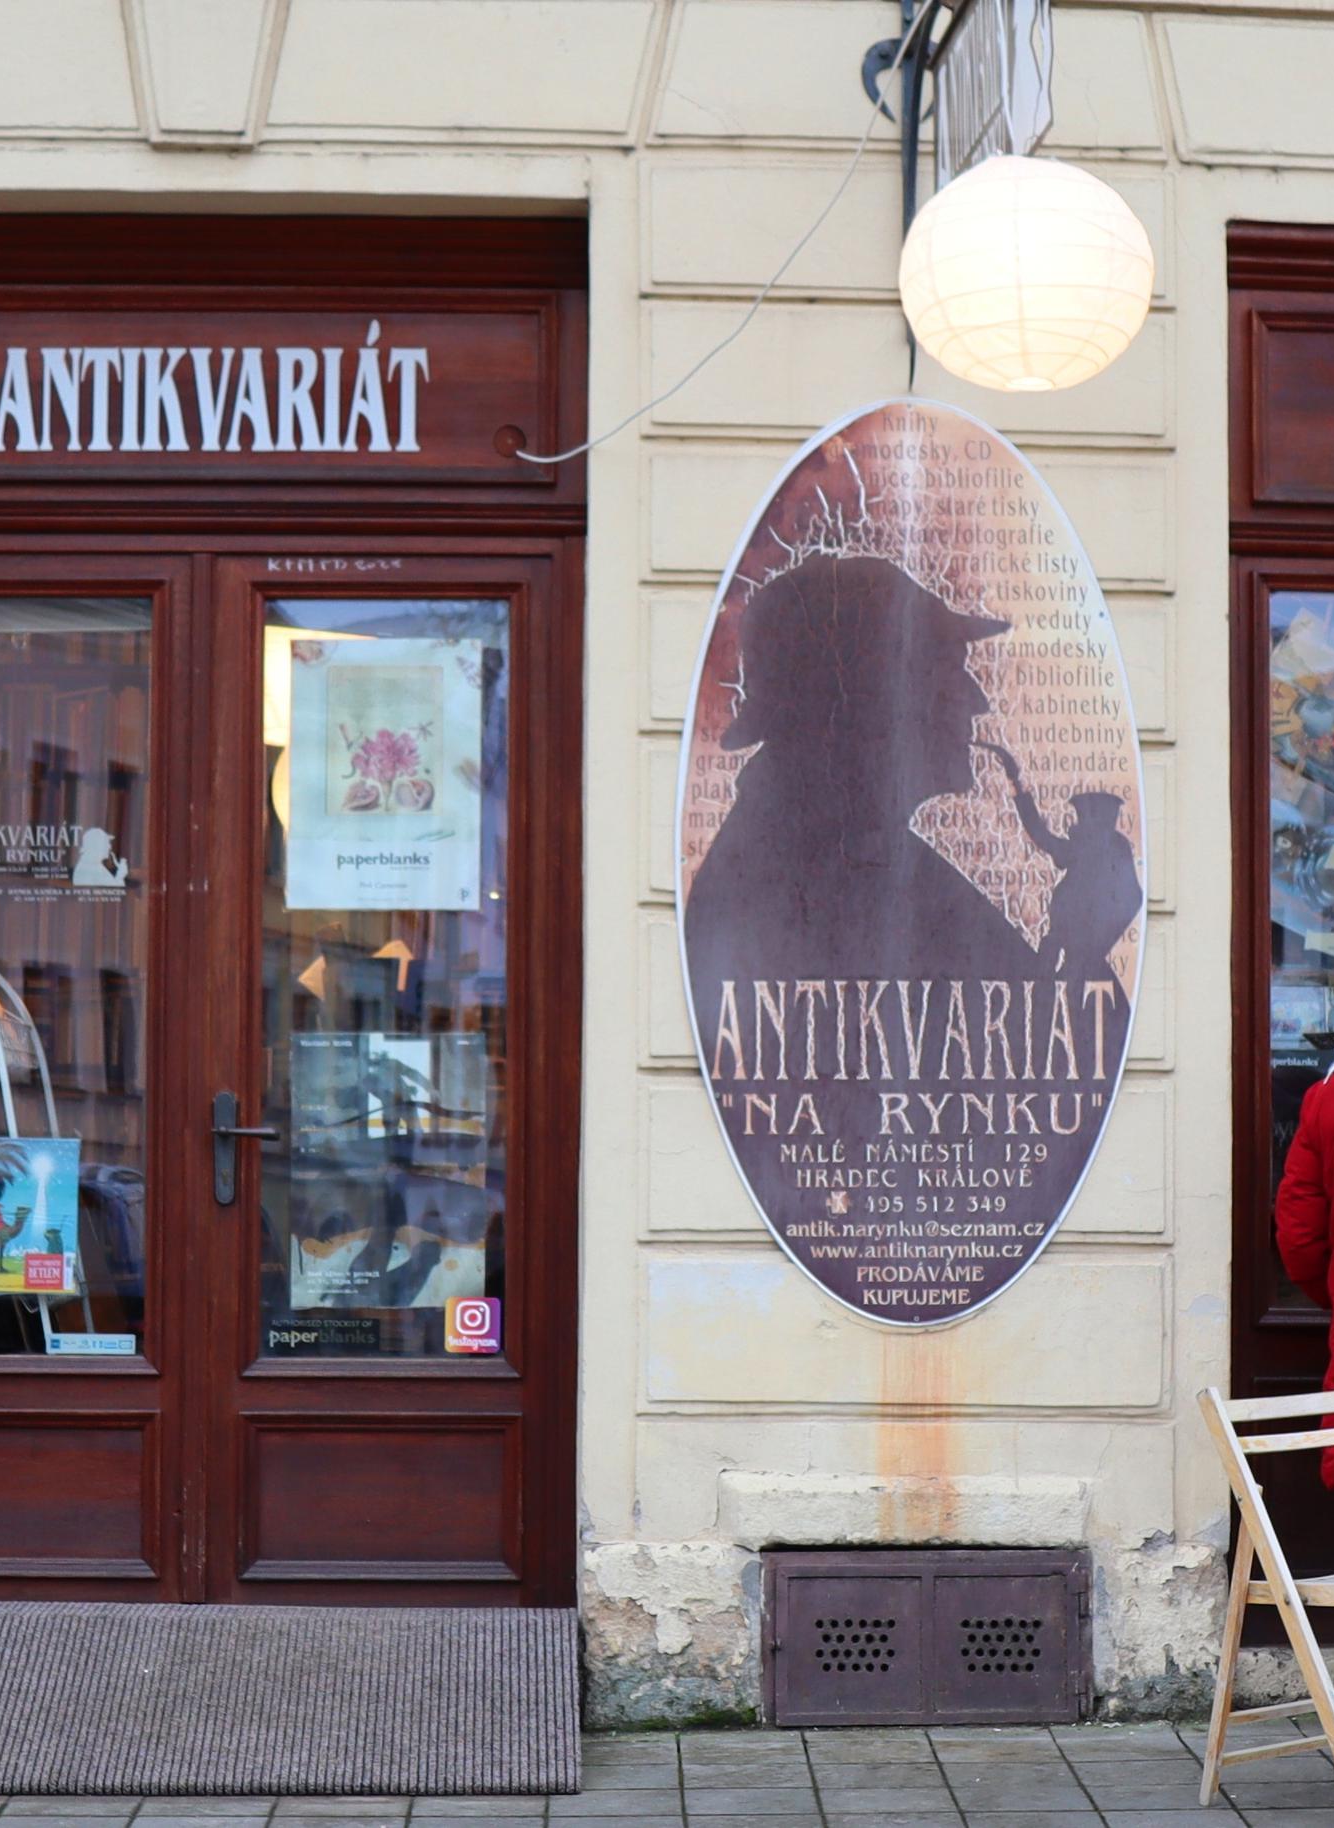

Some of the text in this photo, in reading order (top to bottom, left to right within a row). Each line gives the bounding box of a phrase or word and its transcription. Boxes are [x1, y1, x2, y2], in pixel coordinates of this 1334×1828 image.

[882, 414, 939, 434] Knihy
[965, 439, 992, 461] CD
[925, 467, 1025, 488] bibliofilie
[992, 497, 1040, 523] tisky
[954, 524, 1055, 547] fotografie
[949, 553, 1032, 577] grafické
[1038, 554, 1079, 576] listy
[996, 581, 1088, 606] tiskoviny
[1026, 611, 1092, 635] veduty
[987, 639, 1107, 664] gramodesky
[1017, 664, 1115, 687] bibliofilie
[1023, 694, 1121, 720] kabinetky
[1020, 722, 1126, 748] hudebniny
[337, 852, 431, 870] paperblanks
[711, 948, 1116, 1081] ANTIKVARIÁT
[1271, 1057, 1319, 1068] perblanks
[722, 1092, 1103, 1136] "NA RYNKU"
[780, 1139, 1048, 1163] MALÉ NÁMĚSTÍ 129
[796, 1163, 1033, 1189] HRADEC KRÁLOVÉ
[916, 1195, 955, 1213] 512
[967, 1195, 1007, 1213] 349
[785, 1219, 1046, 1241] antik.narynku@seznam.cz
[809, 1242, 1025, 1261] www.antiknarynku.cz
[855, 1262, 986, 1284] PRODÁVÁME
[862, 1288, 972, 1306] KUPUJEME
[268, 1328, 376, 1349] paperblanks
[448, 1335, 499, 1351] Instagram
